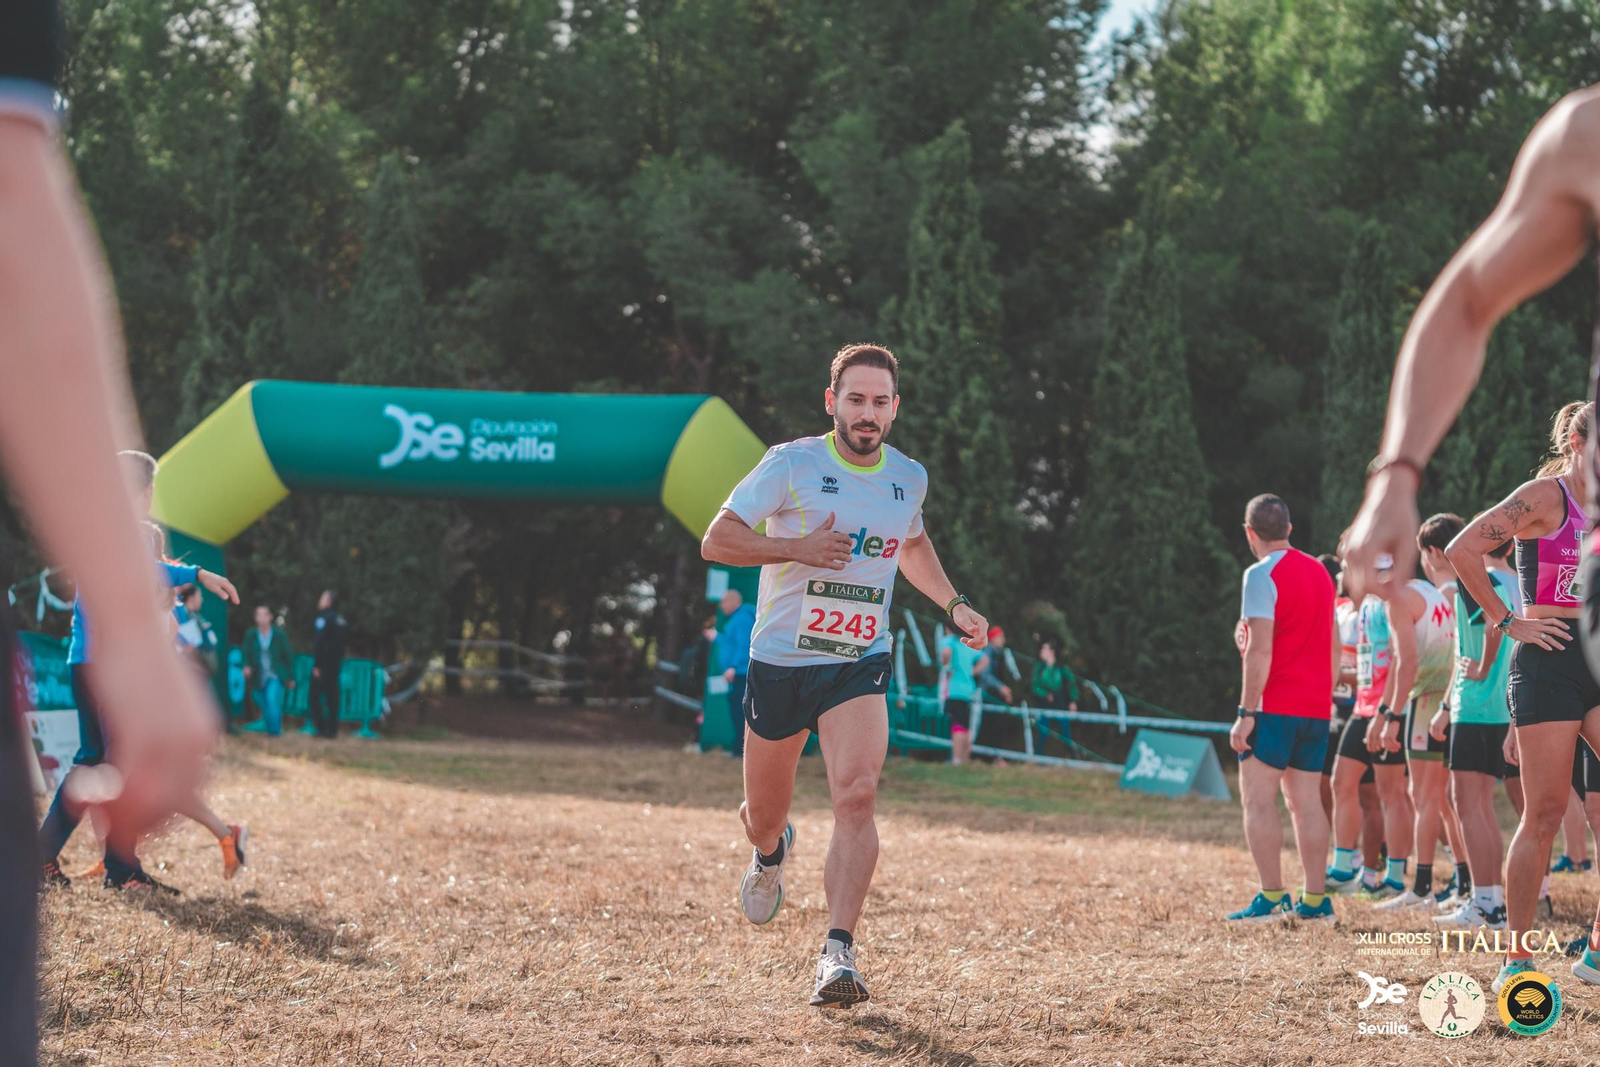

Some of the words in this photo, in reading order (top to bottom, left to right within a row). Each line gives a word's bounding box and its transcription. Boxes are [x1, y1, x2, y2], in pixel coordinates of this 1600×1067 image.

[470, 436, 556, 462] Sevilla
[835, 527, 899, 559] dea
[1560, 547, 1581, 556] SOB
[830, 584, 869, 598] ITÁLICA
[807, 608, 877, 641] 2243
